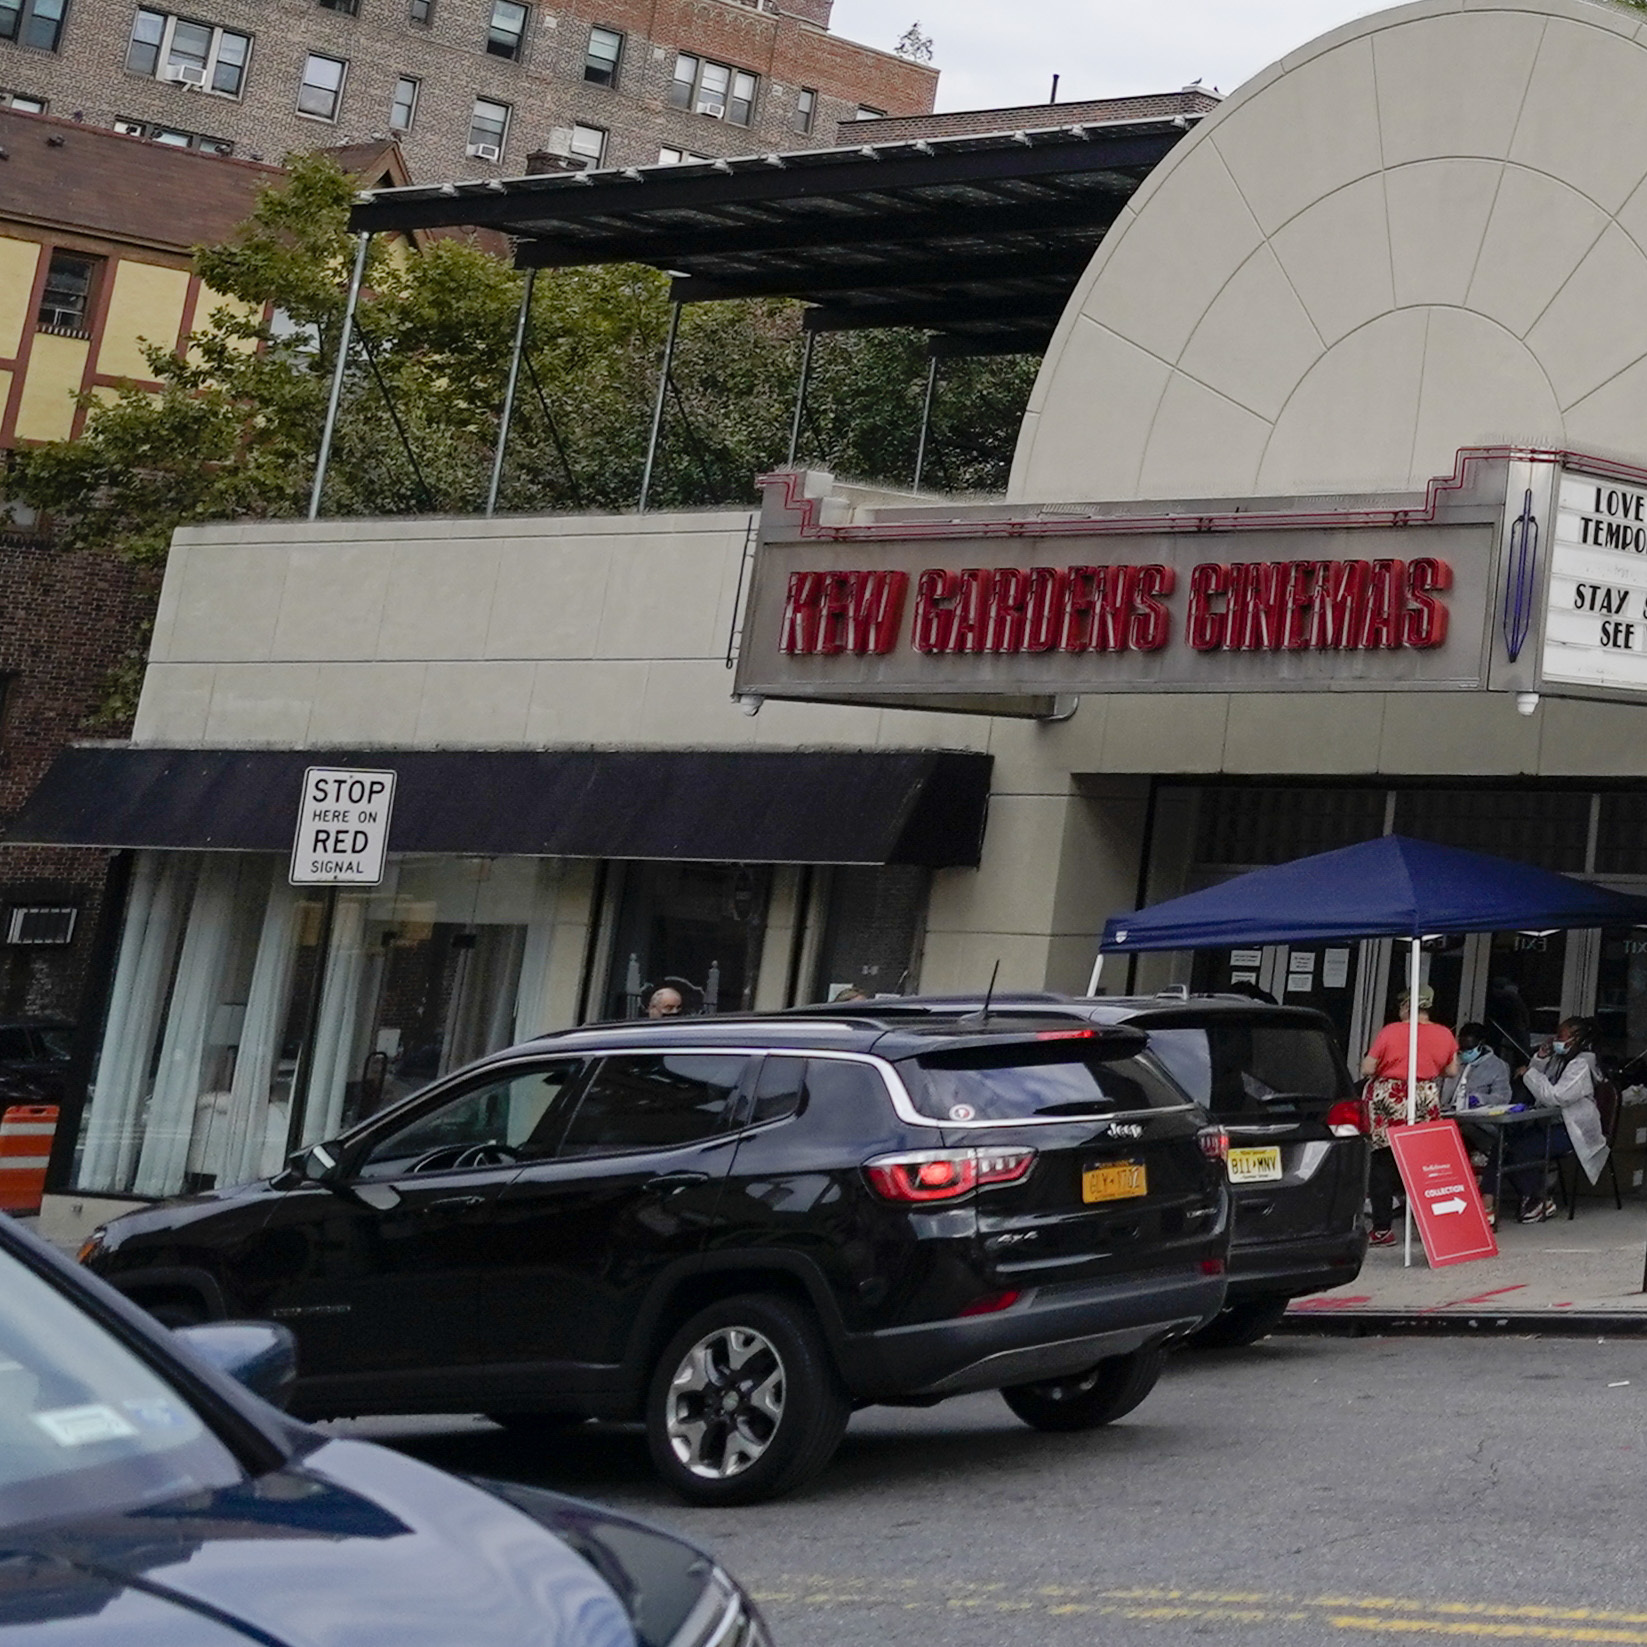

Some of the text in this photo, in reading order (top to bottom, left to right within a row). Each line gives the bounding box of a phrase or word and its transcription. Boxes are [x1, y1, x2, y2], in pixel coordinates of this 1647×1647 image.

[1595, 487, 1645, 522] LOVE
[778, 557, 1452, 654] KEW GARDENS CINEMAS
[1574, 583, 1629, 615] STAY
[1600, 621, 1634, 650] SEE
[313, 779, 385, 804] STOP
[312, 810, 377, 823] HERE ON
[313, 829, 368, 853] RED
[310, 860, 364, 873] SIGNAL
[1107, 1122, 1143, 1140] Jeep
[1424, 1184, 1465, 1198] COLLECTION
